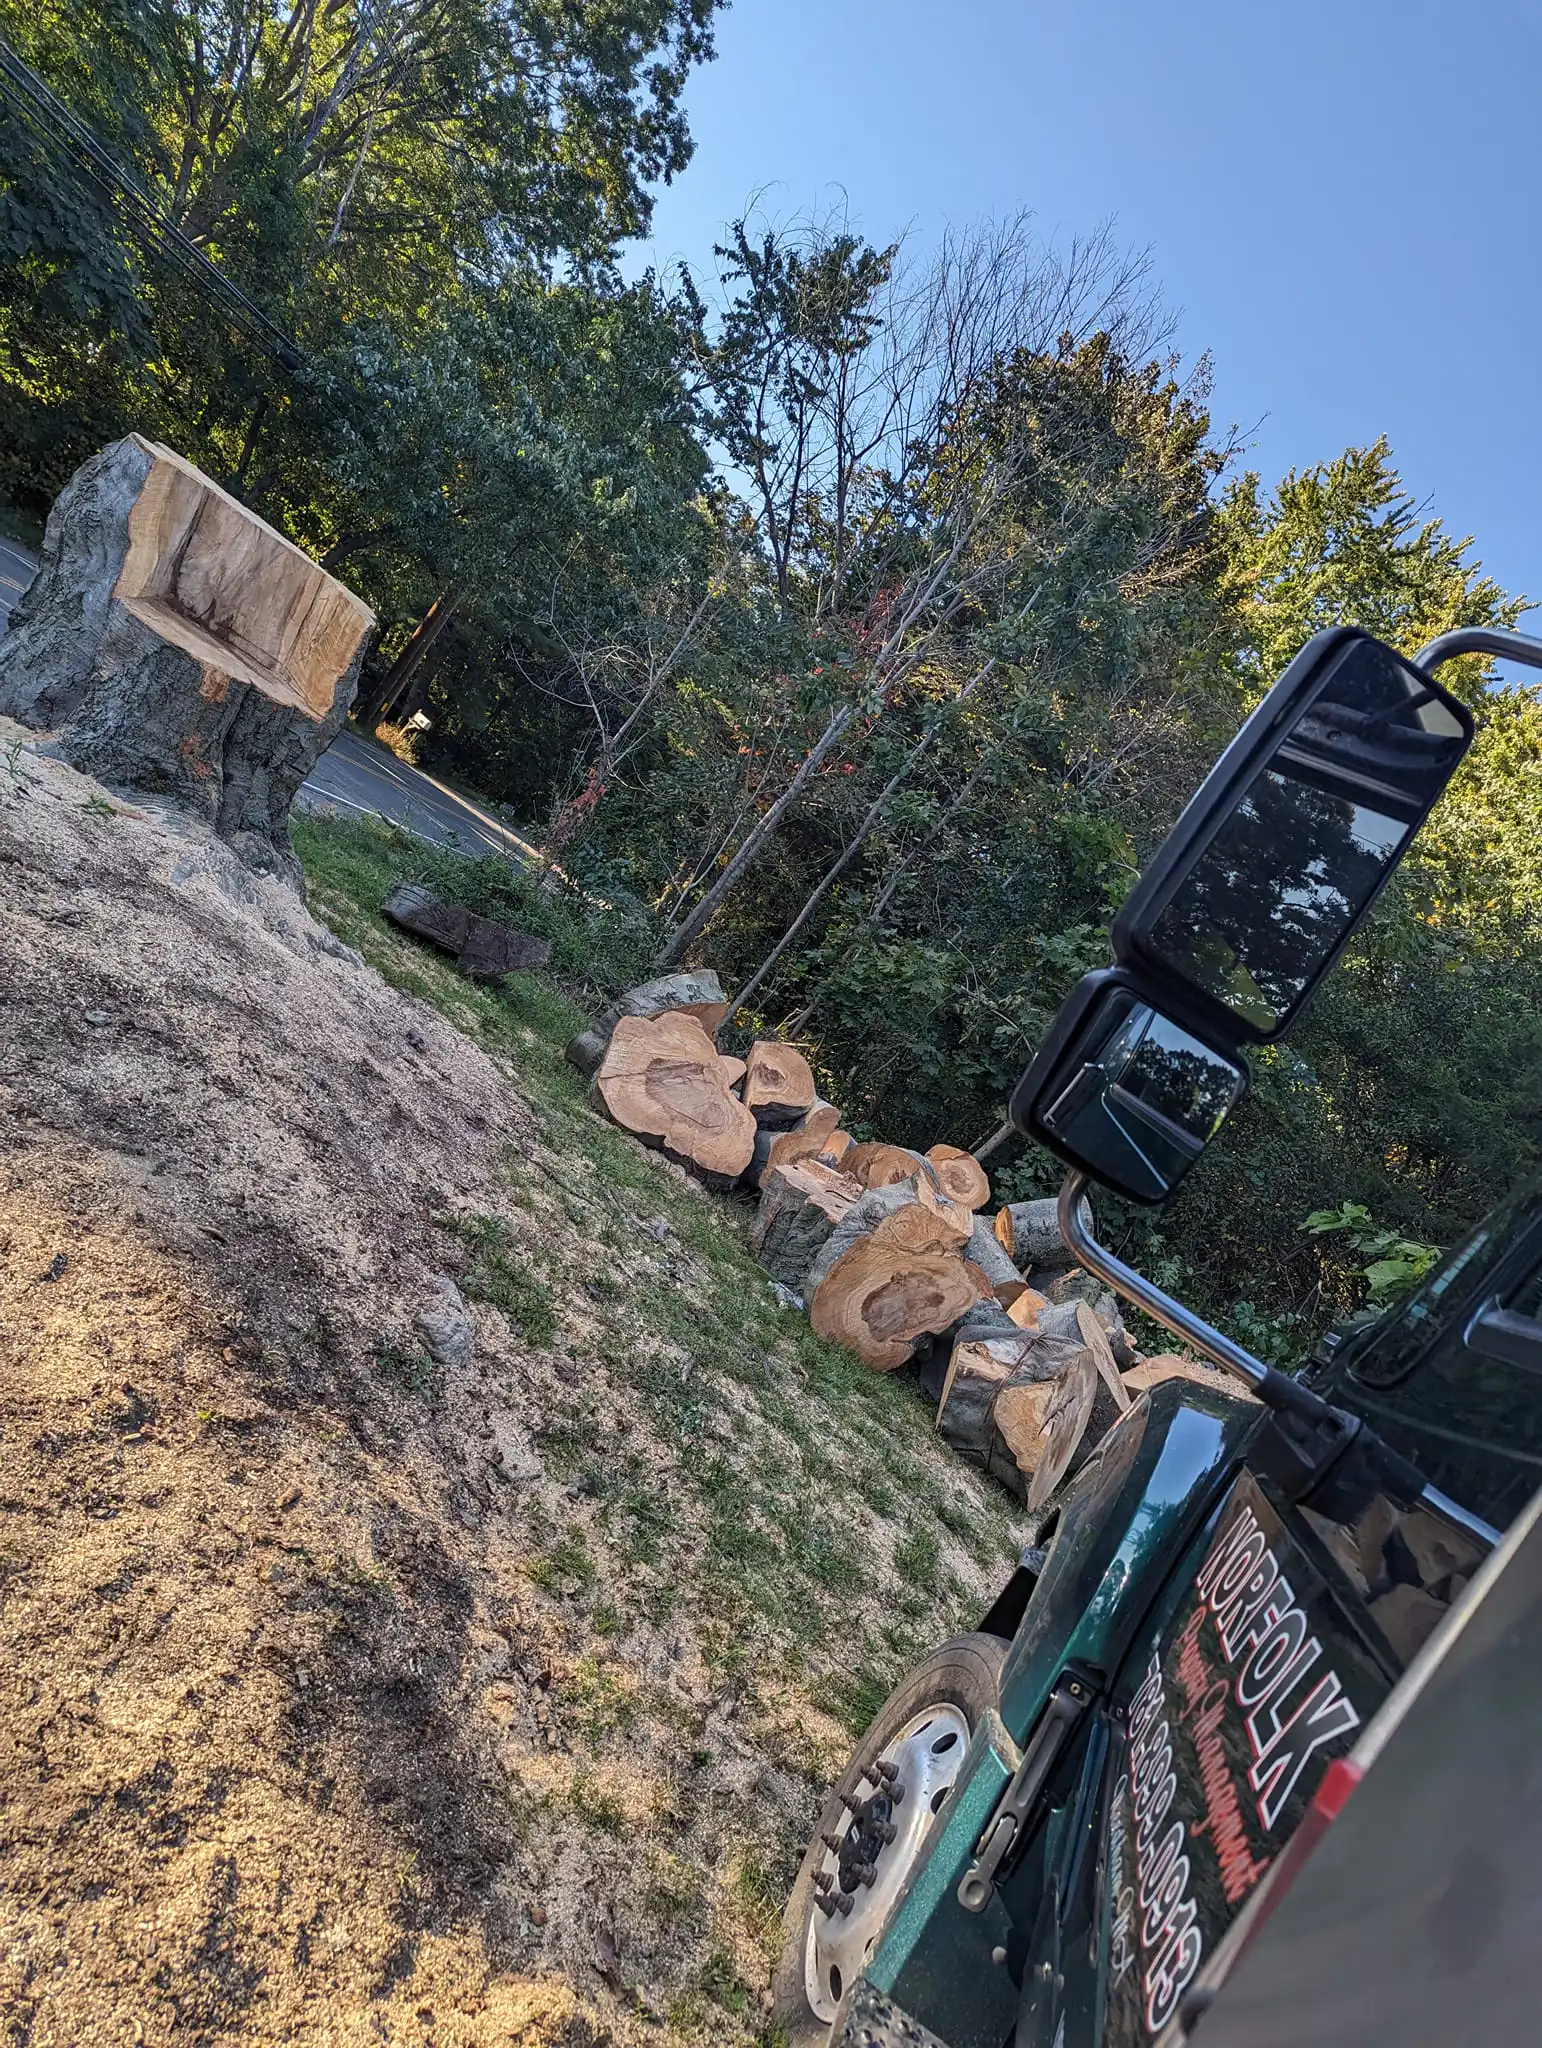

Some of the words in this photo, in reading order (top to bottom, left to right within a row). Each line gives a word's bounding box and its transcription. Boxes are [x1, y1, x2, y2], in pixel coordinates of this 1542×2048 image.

[1177, 1605, 1214, 1720] Property
[1190, 1679, 1270, 1904] Management
[1196, 1506, 1360, 1831] NORFOLK
[1129, 1652, 1202, 2033] 781.899.0913
